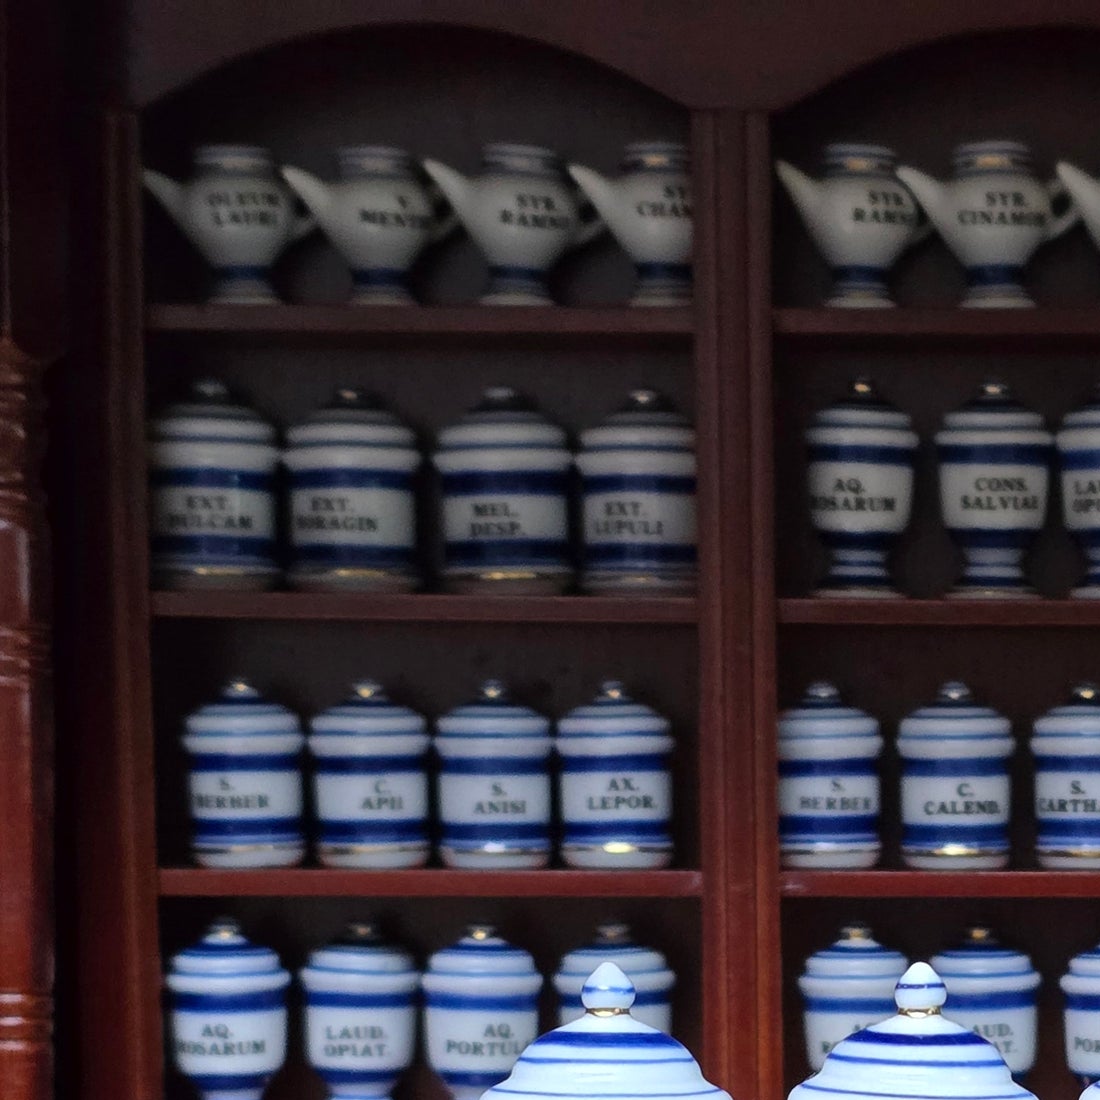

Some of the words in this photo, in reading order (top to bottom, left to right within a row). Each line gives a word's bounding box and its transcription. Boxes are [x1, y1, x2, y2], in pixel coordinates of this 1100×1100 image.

[607, 777, 641, 792] AX.
[956, 782, 975, 798] C.
[1069, 780, 1086, 795] S.
[483, 1022, 514, 1041] AQ.
